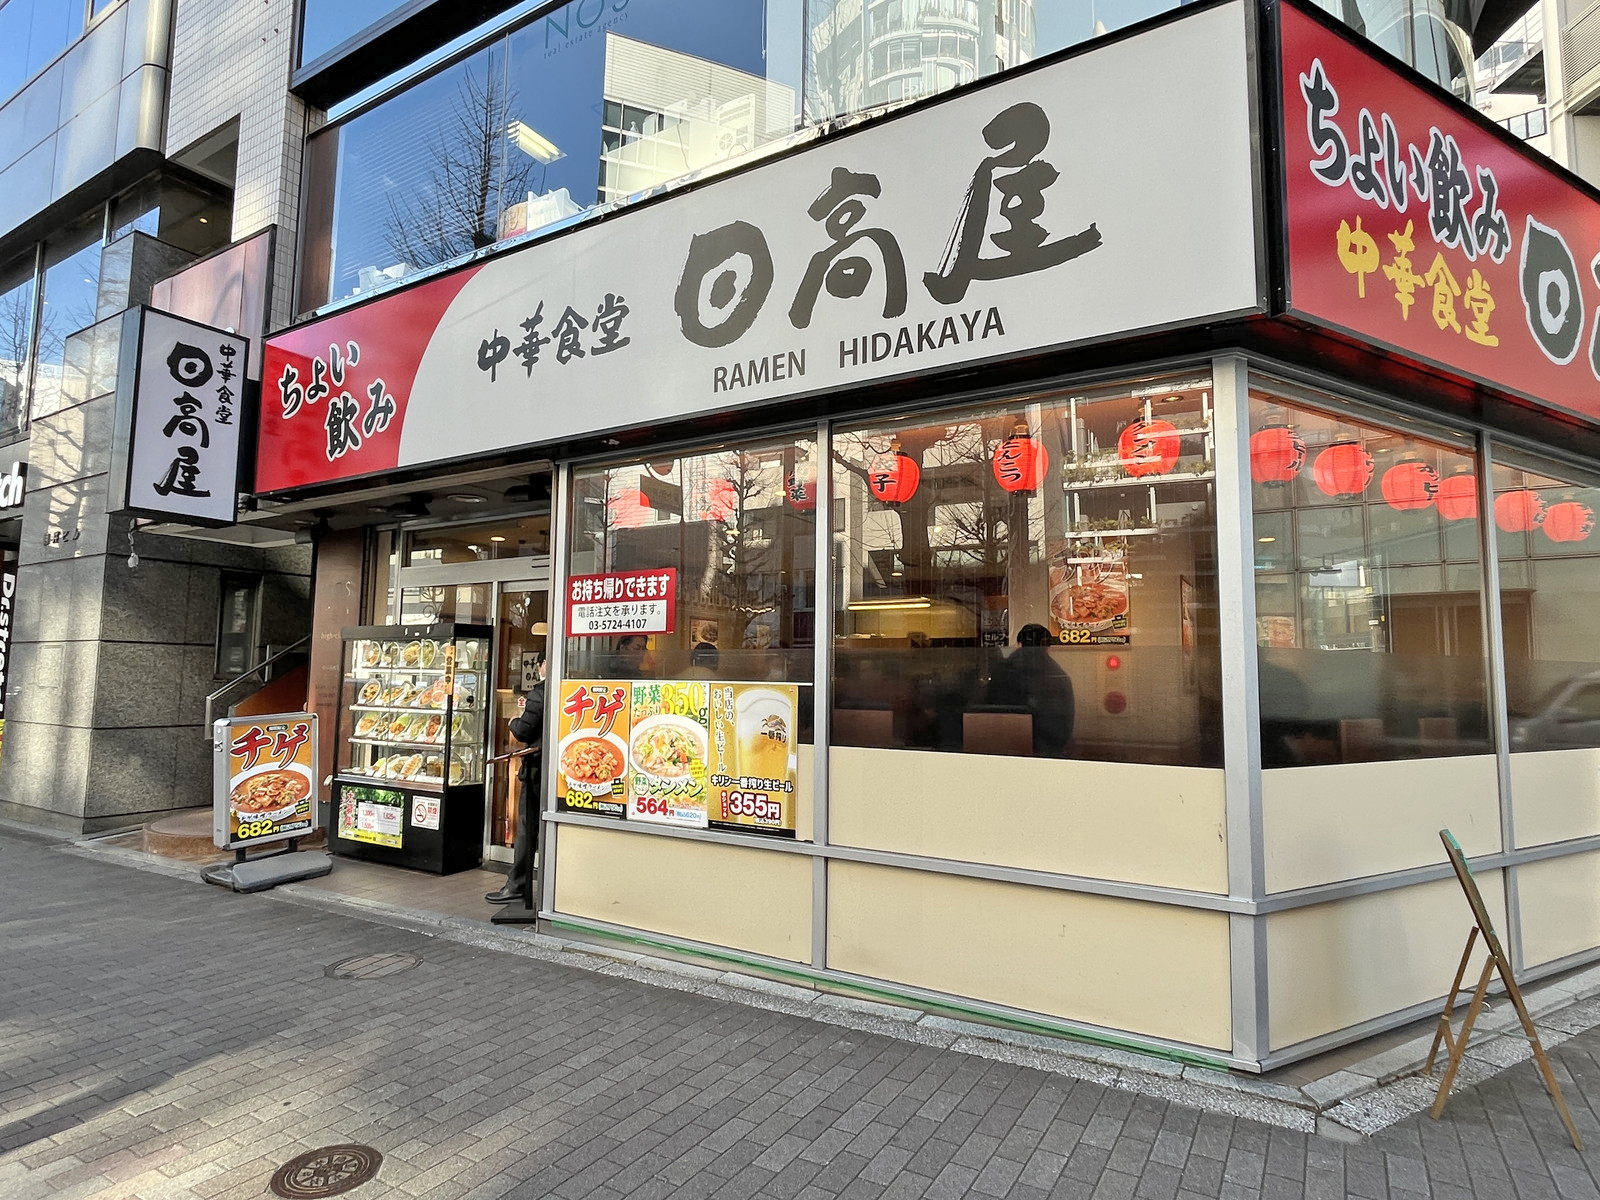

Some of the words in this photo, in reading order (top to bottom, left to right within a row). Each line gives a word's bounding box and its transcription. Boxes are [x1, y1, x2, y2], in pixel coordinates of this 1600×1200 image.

[545, 0, 629, 48] NO
[565, 29, 593, 48] estate
[597, 12, 629, 33] agency
[1299, 58, 1512, 264] ちょい飲み
[673, 101, 1103, 348] 日高屋
[1336, 215, 1499, 347] 中華食堂
[1518, 214, 1600, 385] 日
[477, 293, 631, 383] 中華食堂
[713, 349, 806, 393] RAMEN
[839, 306, 1006, 369] HIDAKAYA
[216, 344, 237, 425] 中華食堂
[278, 341, 361, 419] ちょい
[153, 341, 214, 498] 日高屋
[325, 378, 397, 462] 飲み
[0, 461, 23, 507] ch
[571, 573, 670, 602] お持ち帰りできます
[577, 603, 661, 618] 電話注文を承ります。
[588, 618, 647, 630] 03-5724-4107
[1059, 629, 1097, 643] 682円
[563, 685, 625, 737] チゲ
[633, 684, 661, 706] 野菜
[633, 705, 661, 718] たっぷり
[724, 687, 734, 726] 当店の、
[229, 724, 308, 770] チゲ
[713, 689, 726, 773] おいしい生ビール
[565, 789, 599, 810] 682円
[636, 796, 675, 816] 564円
[649, 778, 704, 798] タンメン
[711, 774, 793, 793] キリン一番搾り生ビール
[730, 791, 781, 820] 355円
[237, 818, 280, 839] 682円
